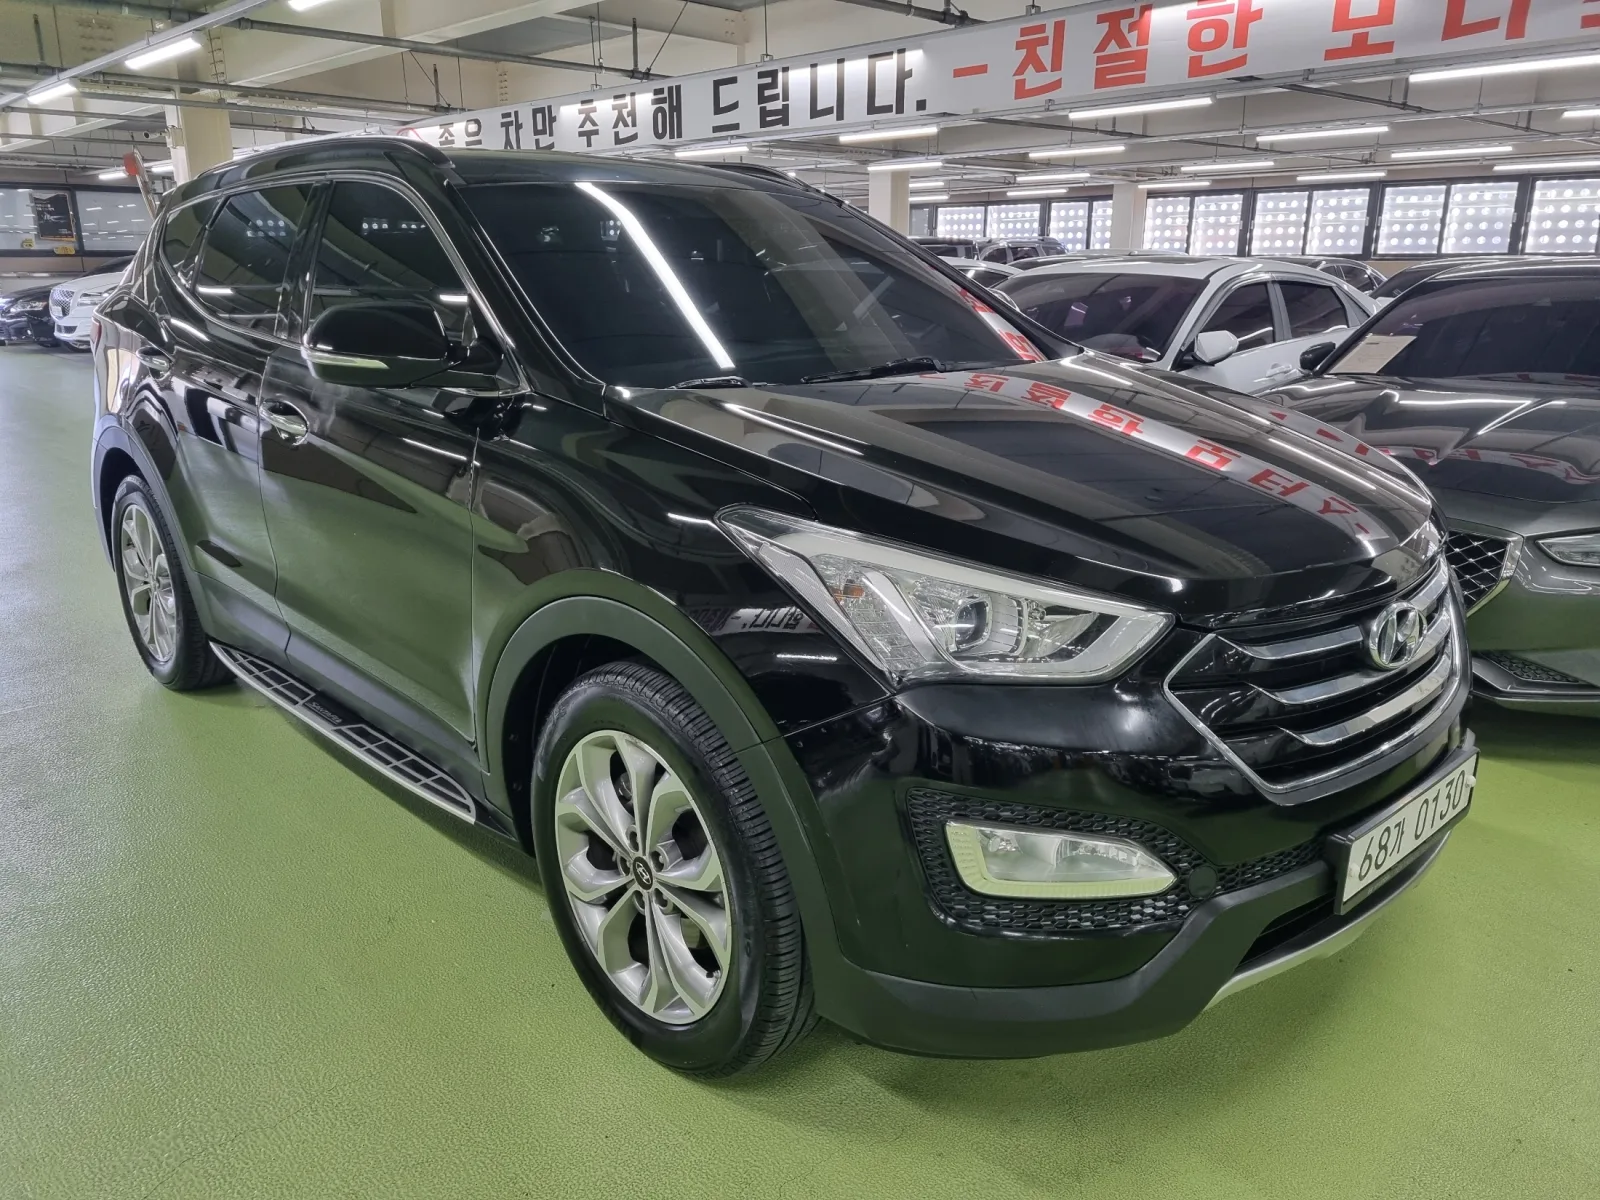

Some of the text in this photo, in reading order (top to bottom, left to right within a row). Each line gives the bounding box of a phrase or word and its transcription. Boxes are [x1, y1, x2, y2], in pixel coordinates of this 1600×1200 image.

[500, 105, 557, 150] 차만
[577, 84, 682, 148] 추천해
[712, 48, 927, 133] 드립니다.
[1012, 0, 1263, 99] 친절한
[1358, 817, 1405, 882] 68가
[1414, 770, 1466, 840] 0130
